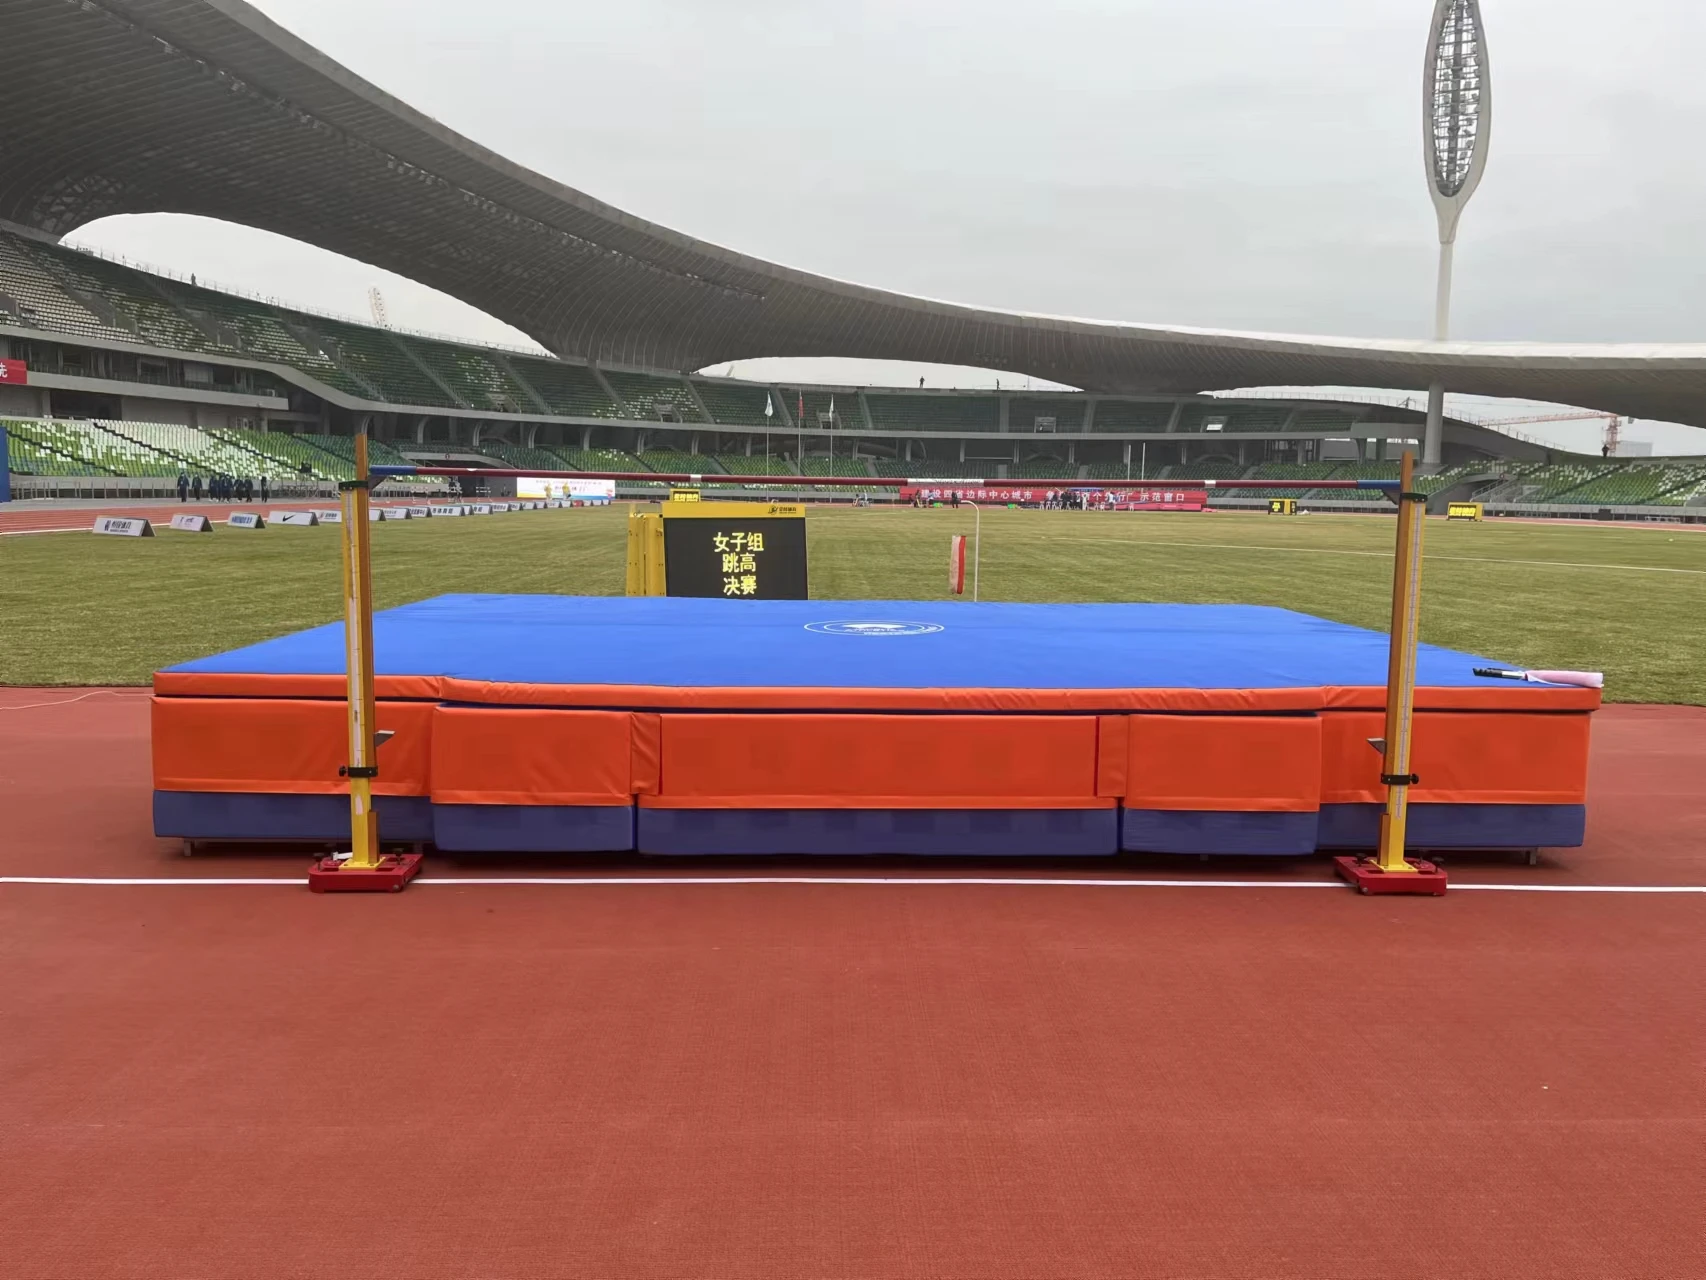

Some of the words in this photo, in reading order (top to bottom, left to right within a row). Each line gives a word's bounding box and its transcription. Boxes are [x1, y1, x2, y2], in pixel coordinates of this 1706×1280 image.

[713, 531, 765, 553] 女子组
[721, 553, 756, 573] 跳高
[723, 575, 757, 596] 决赛
